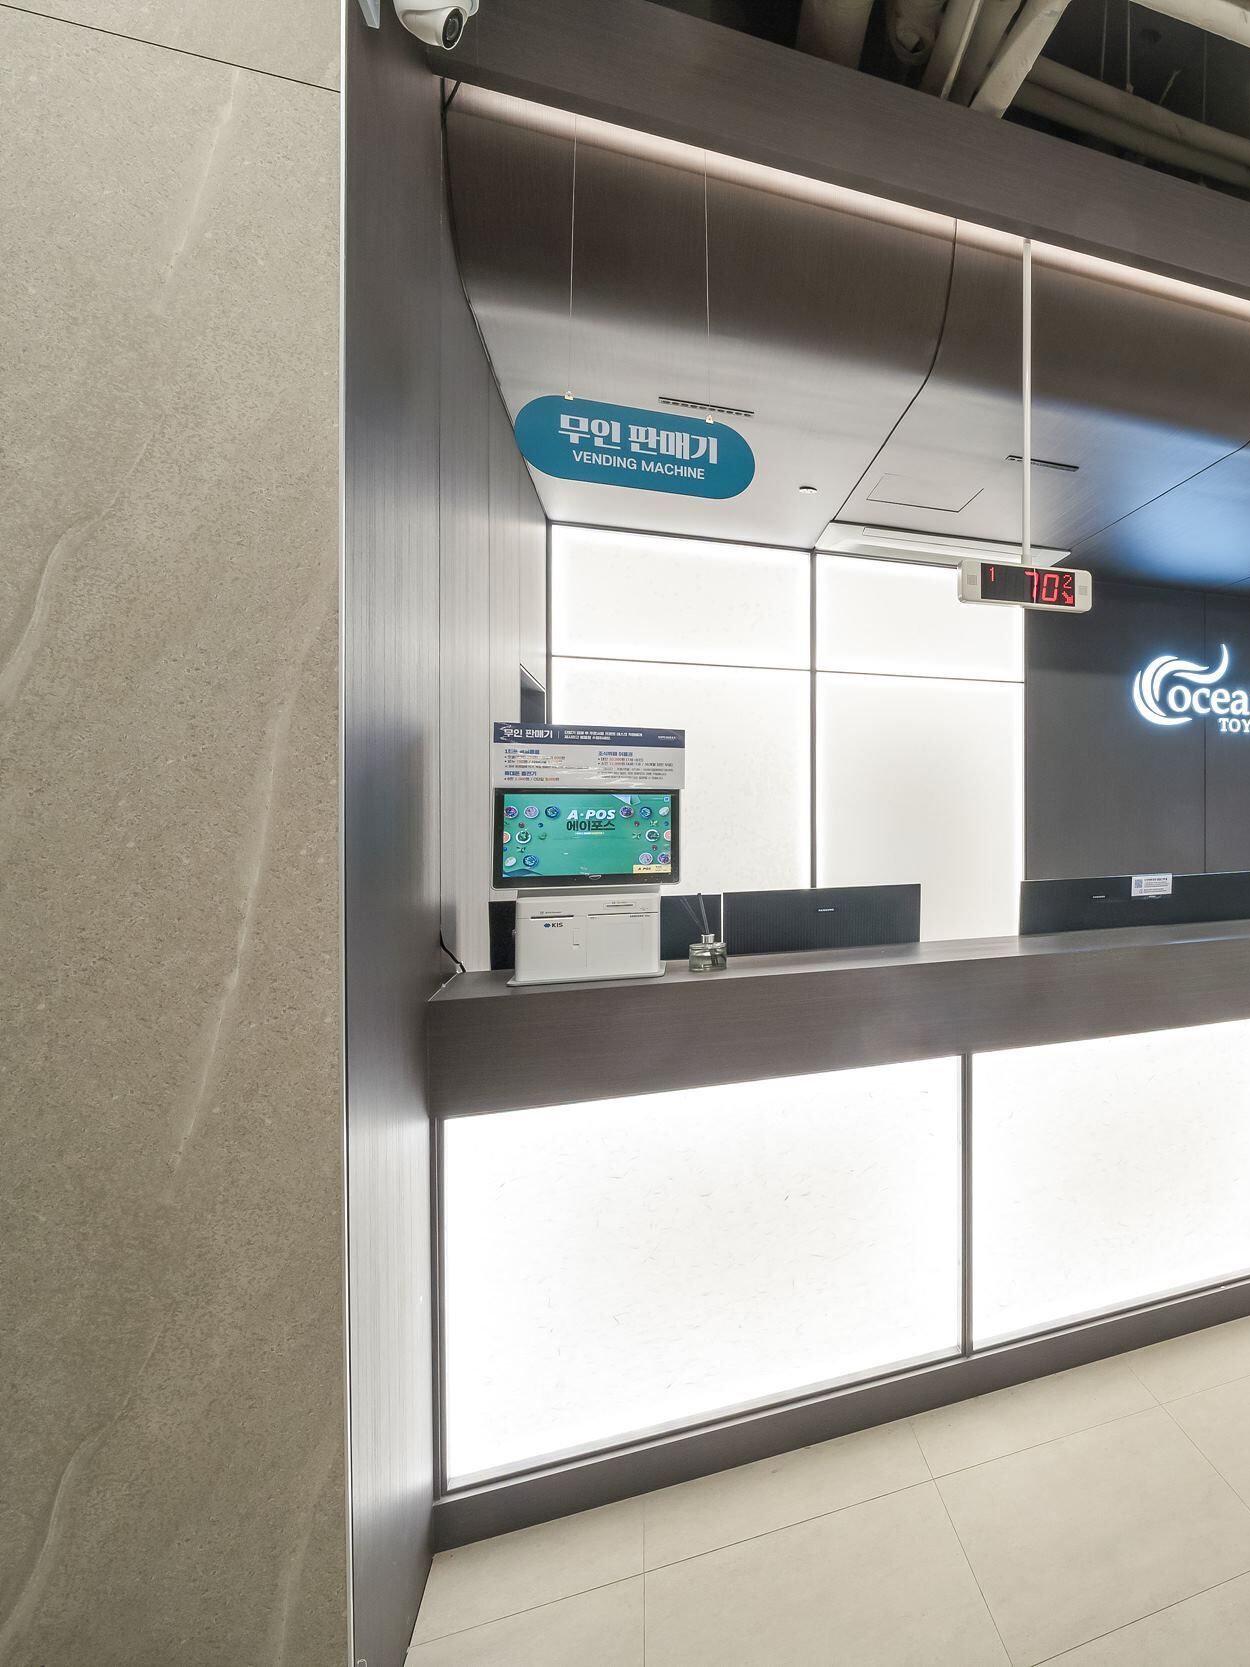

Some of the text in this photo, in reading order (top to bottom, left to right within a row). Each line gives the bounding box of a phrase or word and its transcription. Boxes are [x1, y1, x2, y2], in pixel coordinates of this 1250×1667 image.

[558, 414, 718, 464] 무인 판매기
[572, 450, 705, 480] VENDING MACHINE
[1025, 571, 1059, 602] 70
[1063, 574, 1072, 589] 2
[503, 728, 523, 738] 무인
[525, 729, 553, 739] 판매기
[566, 820, 616, 831] 에이포스
